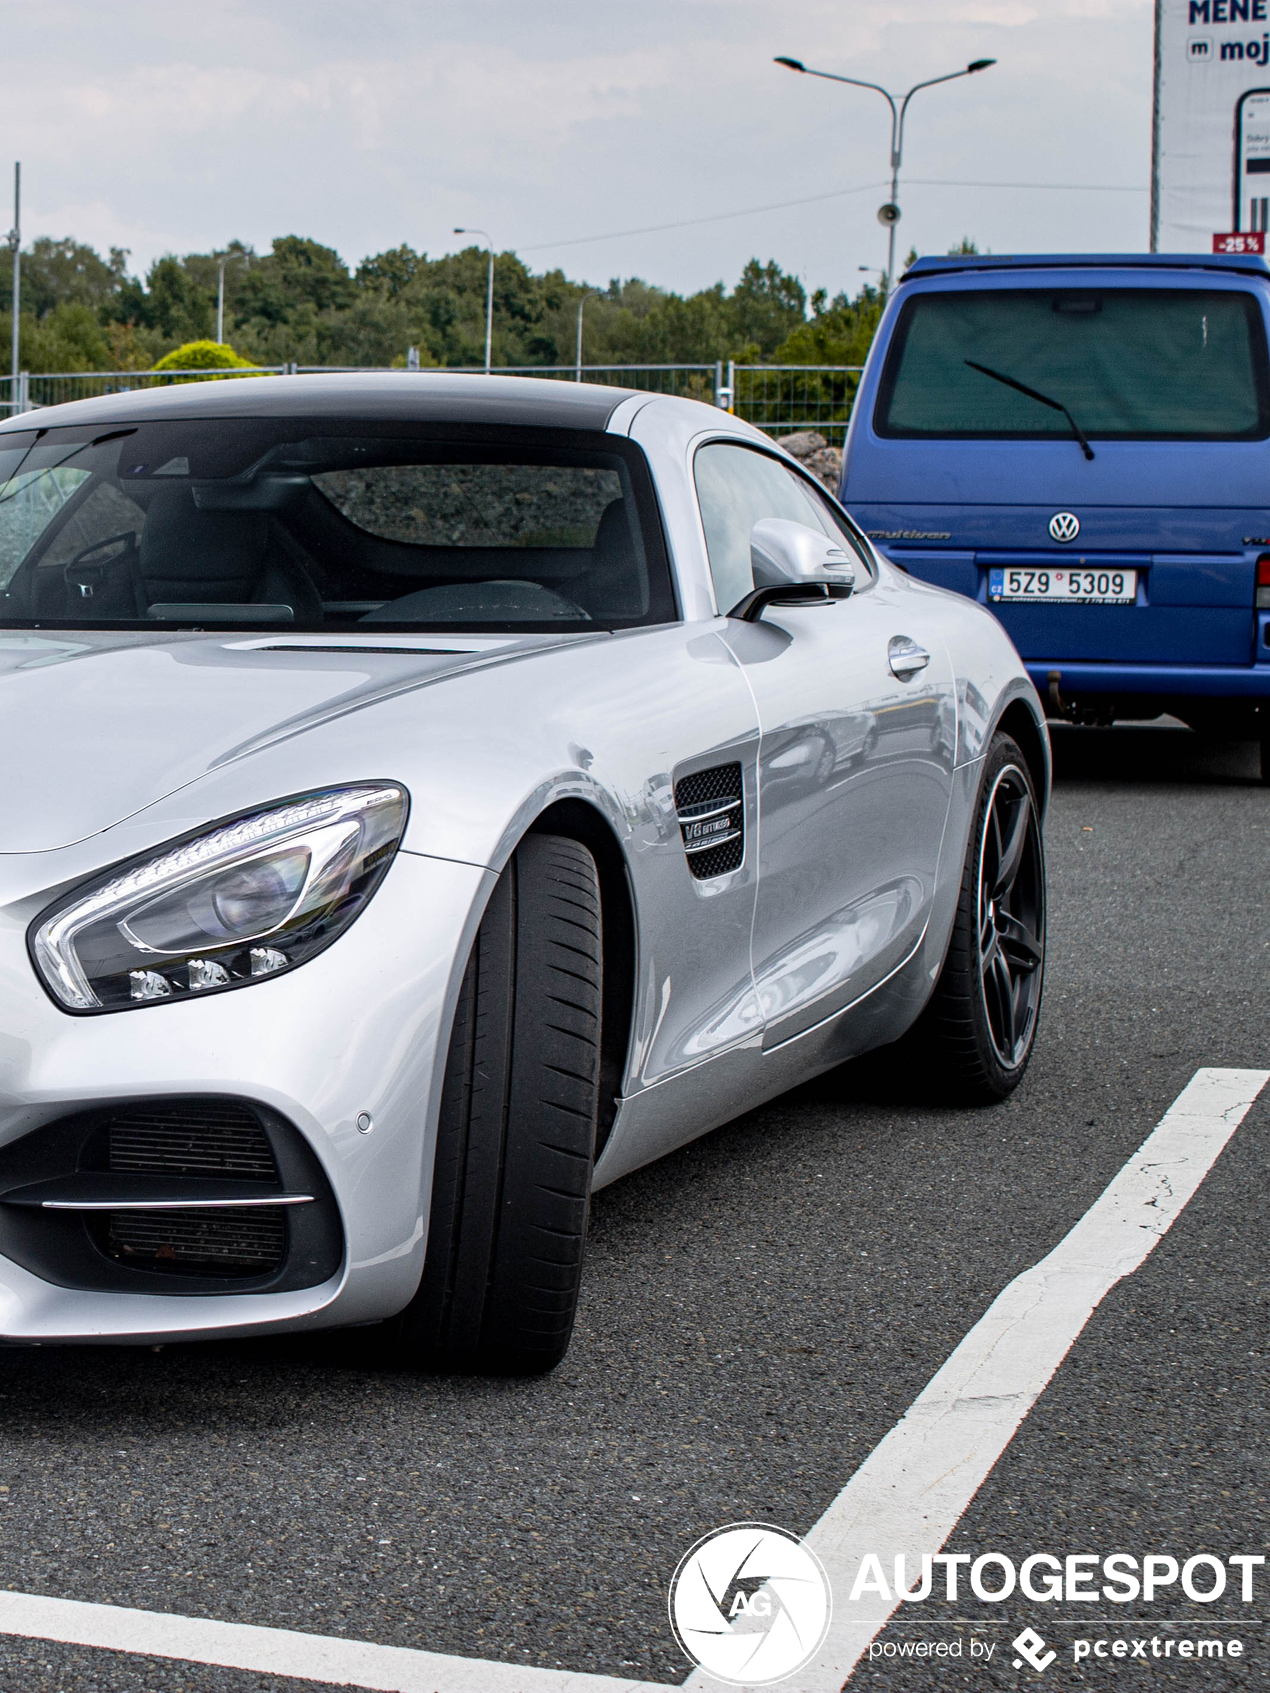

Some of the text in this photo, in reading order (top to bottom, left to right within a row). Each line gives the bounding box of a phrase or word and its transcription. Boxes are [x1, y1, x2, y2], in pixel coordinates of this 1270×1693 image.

[1218, 237, 1245, 252] -25
[866, 530, 951, 539] multivan
[1009, 572, 1124, 595] 5Z9 5309
